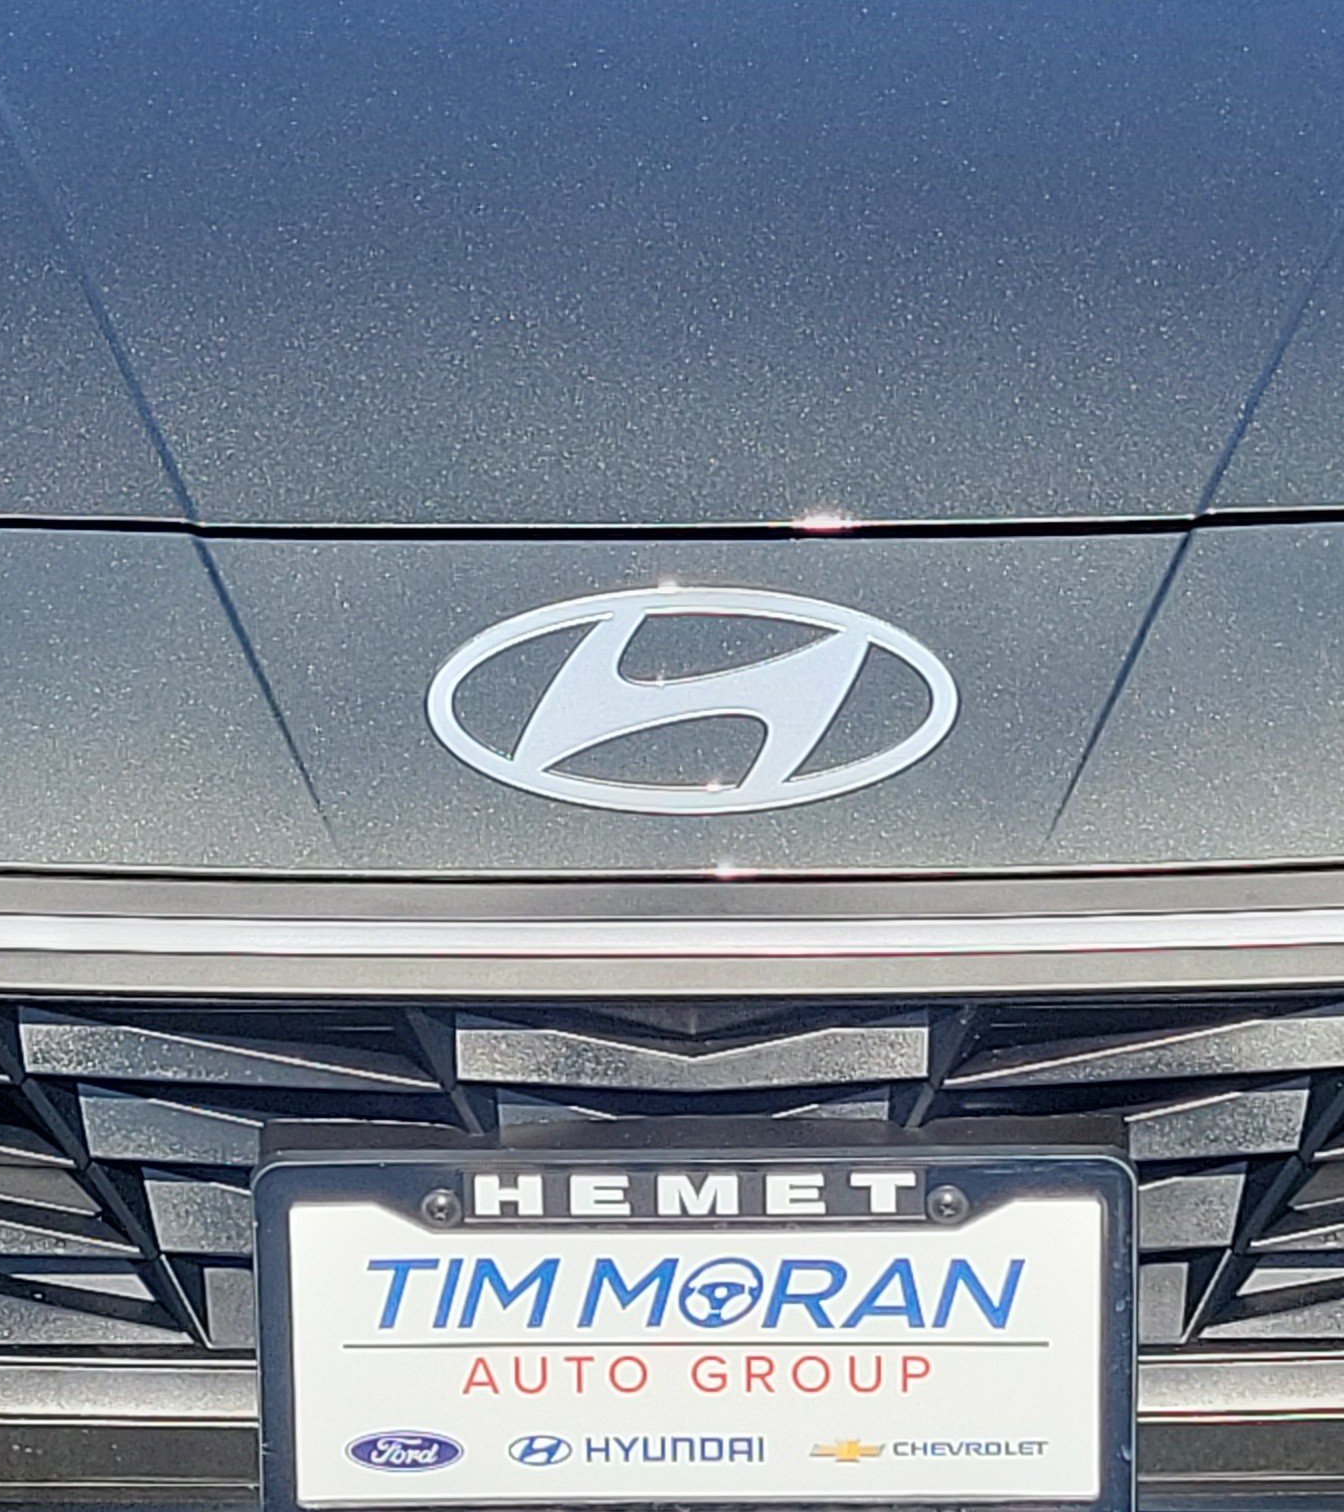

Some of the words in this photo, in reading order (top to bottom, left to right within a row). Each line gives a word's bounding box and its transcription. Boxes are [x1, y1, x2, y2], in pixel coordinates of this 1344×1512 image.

[473, 1172, 917, 1216] HEMET
[367, 1257, 560, 1329] TIM
[577, 1257, 1026, 1329] MORAN
[462, 1355, 648, 1394] AUTO
[691, 1355, 933, 1394] GROUP
[370, 1437, 439, 1465] Ford
[585, 1436, 765, 1463] HYUNDAI
[892, 1440, 1050, 1457] CHEVROLET
